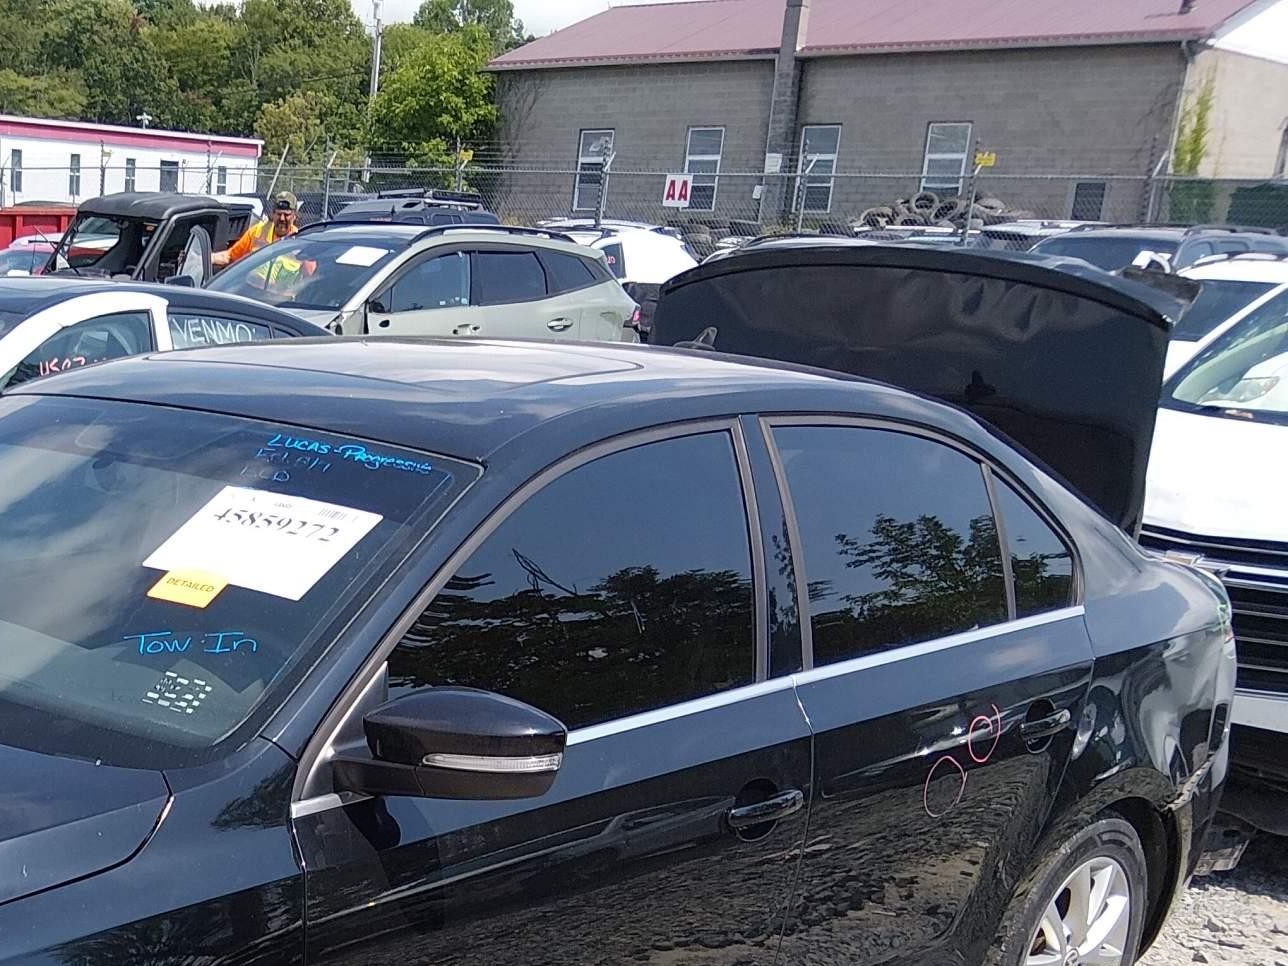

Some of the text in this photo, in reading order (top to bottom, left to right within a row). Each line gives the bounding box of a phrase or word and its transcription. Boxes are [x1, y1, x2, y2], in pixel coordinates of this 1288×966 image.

[665, 179, 689, 202] AA
[213, 507, 340, 542] 45859272
[166, 577, 215, 594] DETAILED
[123, 631, 258, 655] Tow In
